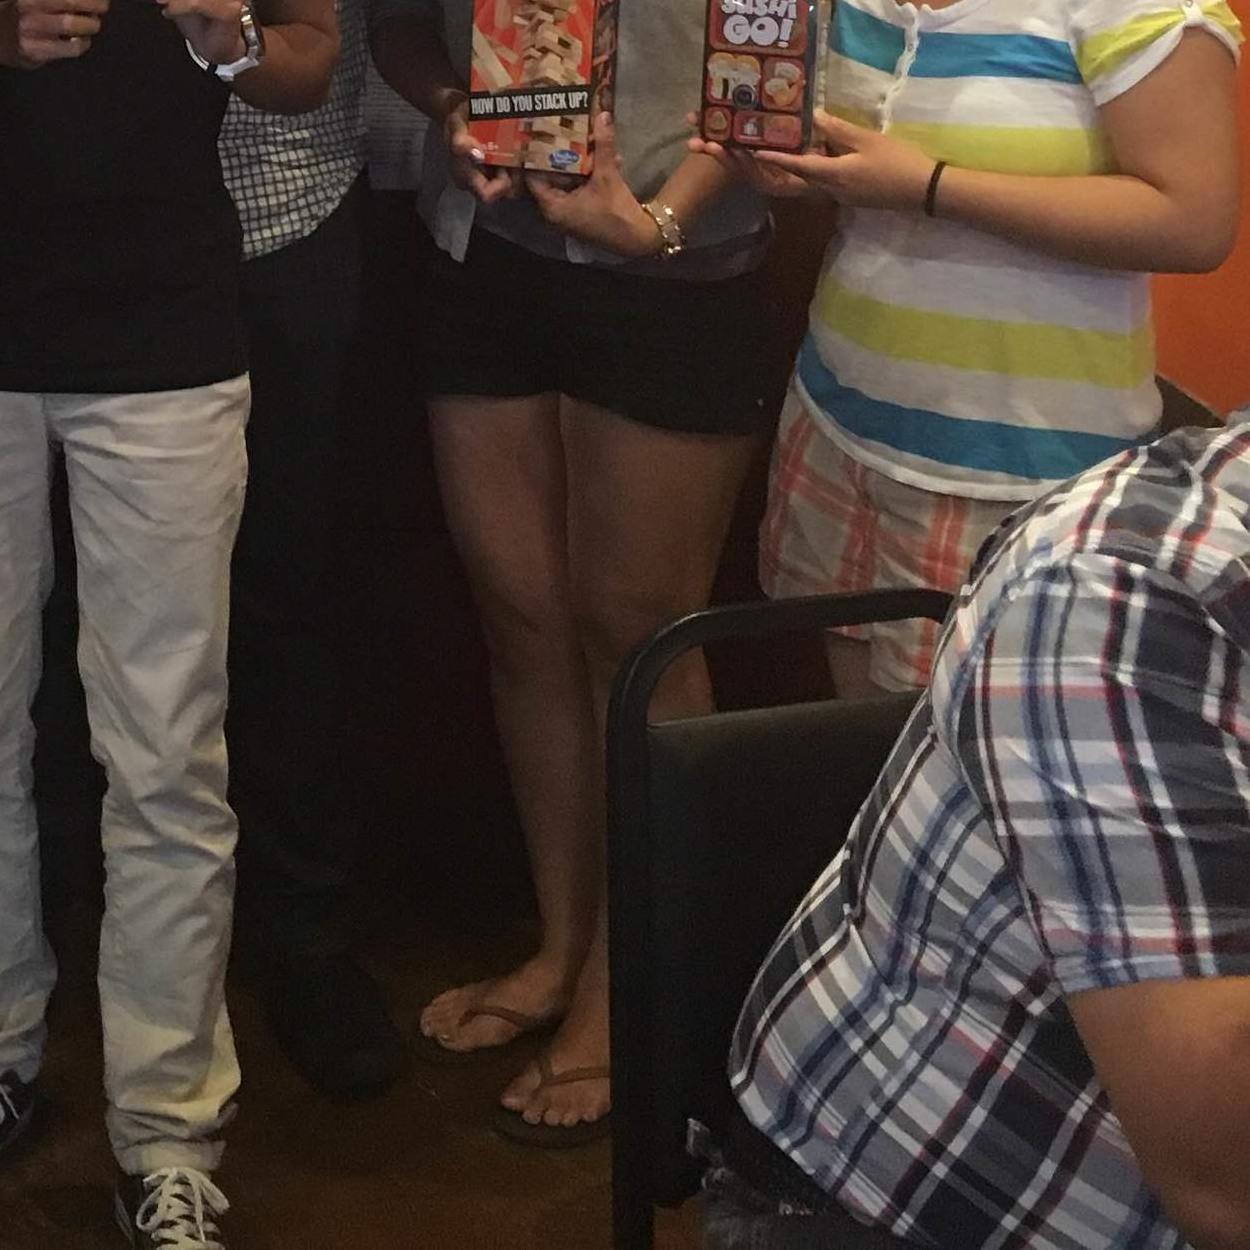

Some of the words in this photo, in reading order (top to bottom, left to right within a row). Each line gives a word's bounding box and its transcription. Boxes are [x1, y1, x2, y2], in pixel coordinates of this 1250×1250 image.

[723, 14, 793, 48] GO!
[471, 97, 494, 114] HOW
[496, 96, 510, 113] DO
[512, 95, 532, 112] YOU
[534, 92, 567, 111] STACK
[569, 91, 588, 108] UP?
